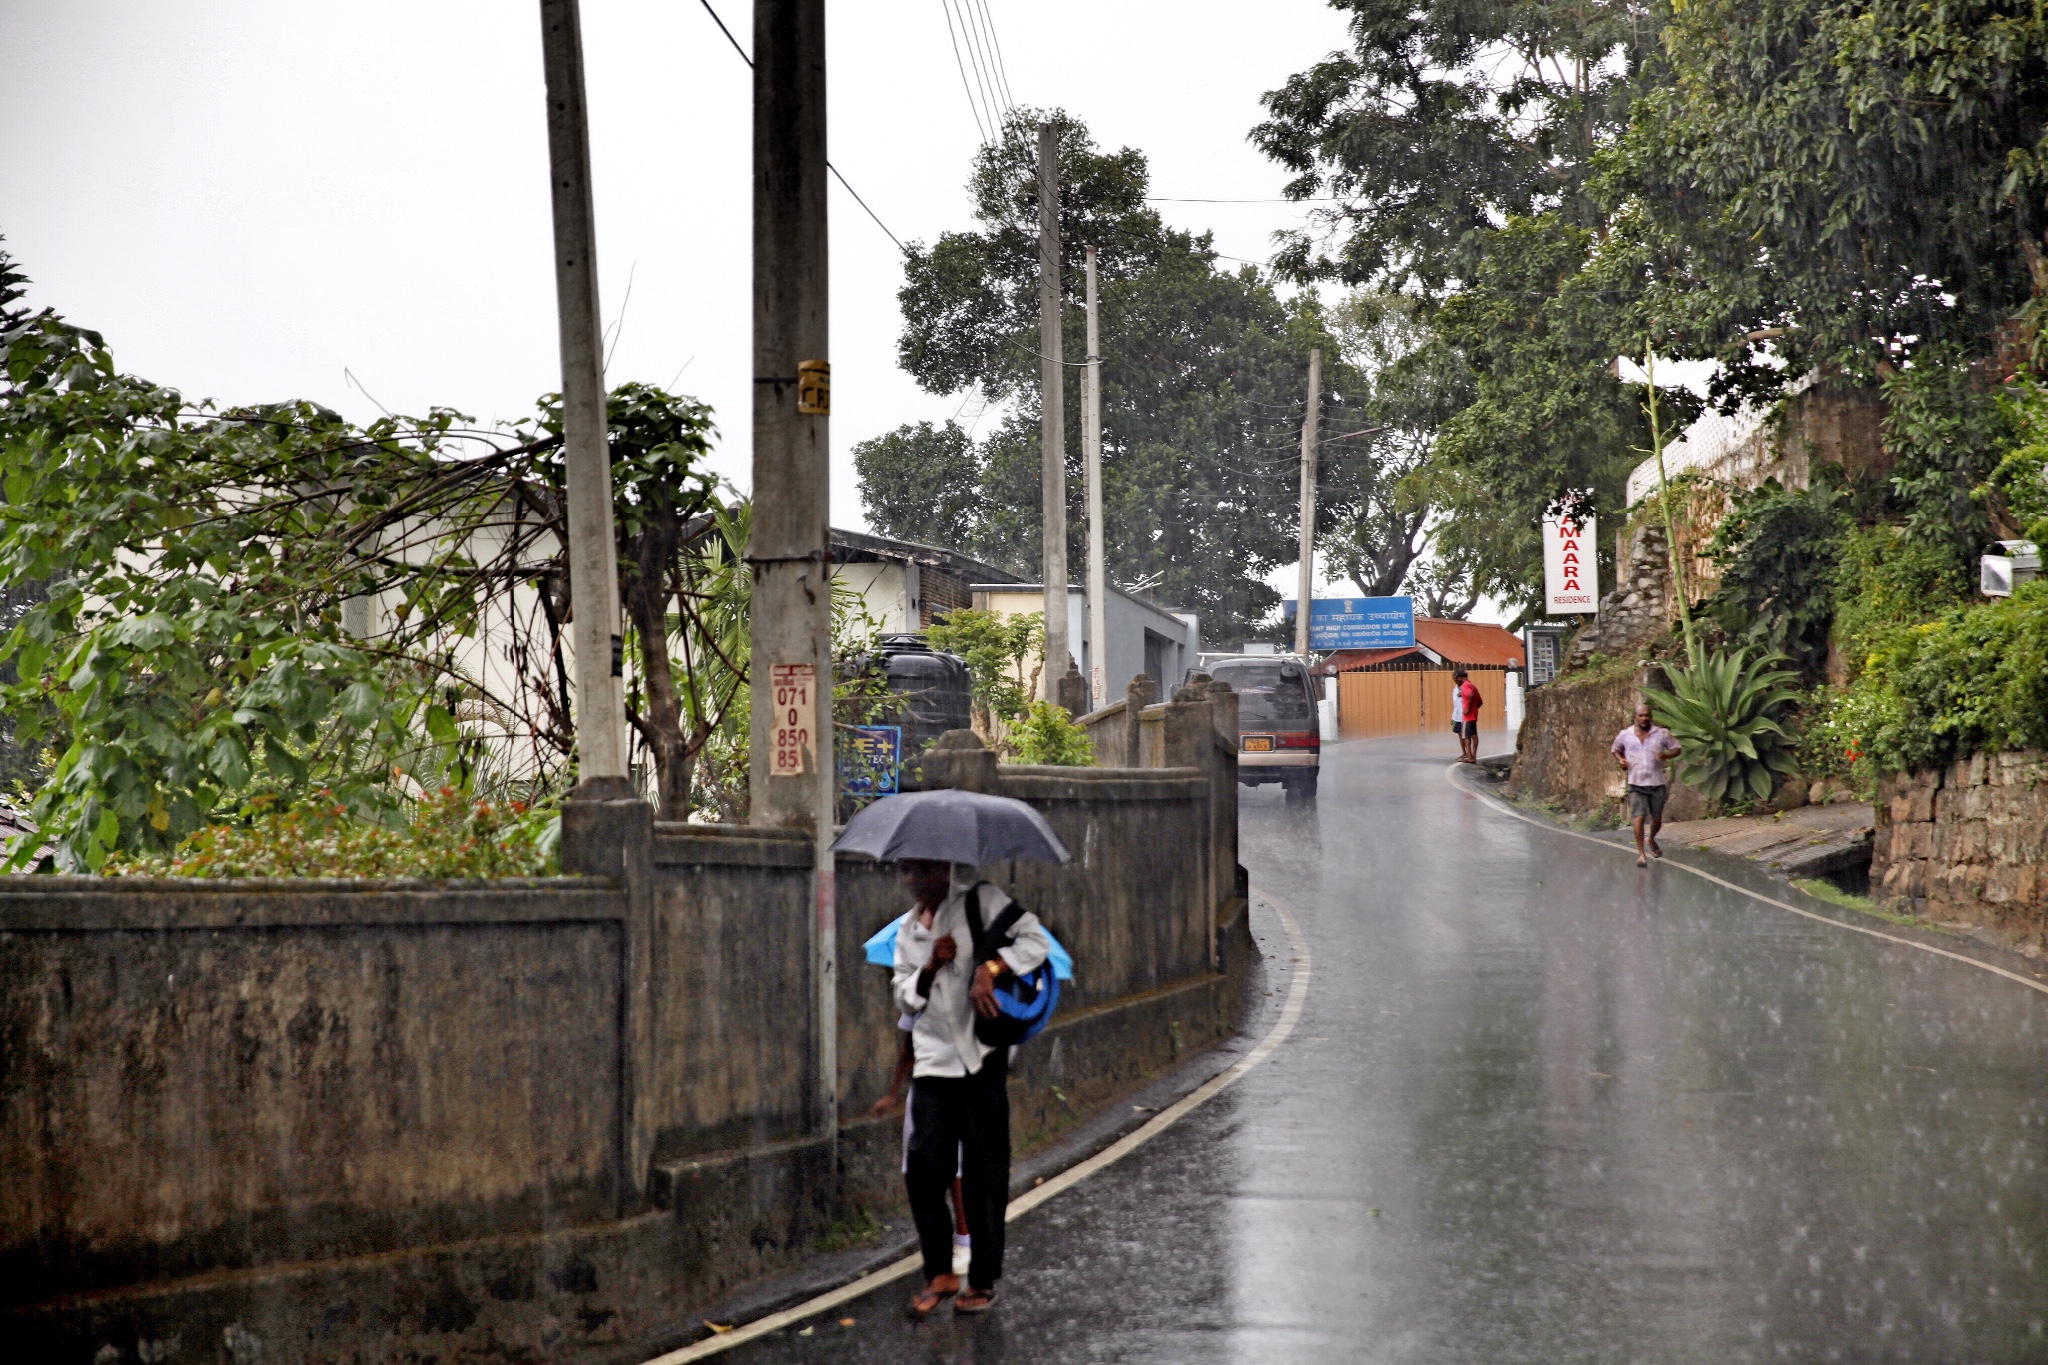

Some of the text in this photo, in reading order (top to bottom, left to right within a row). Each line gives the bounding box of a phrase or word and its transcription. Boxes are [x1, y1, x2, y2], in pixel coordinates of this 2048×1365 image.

[1554, 596, 1591, 604] RESIDENCE
[777, 687, 806, 706] 071
[787, 708, 798, 726] 0
[777, 728, 808, 747] 850
[777, 749, 800, 768] 85
